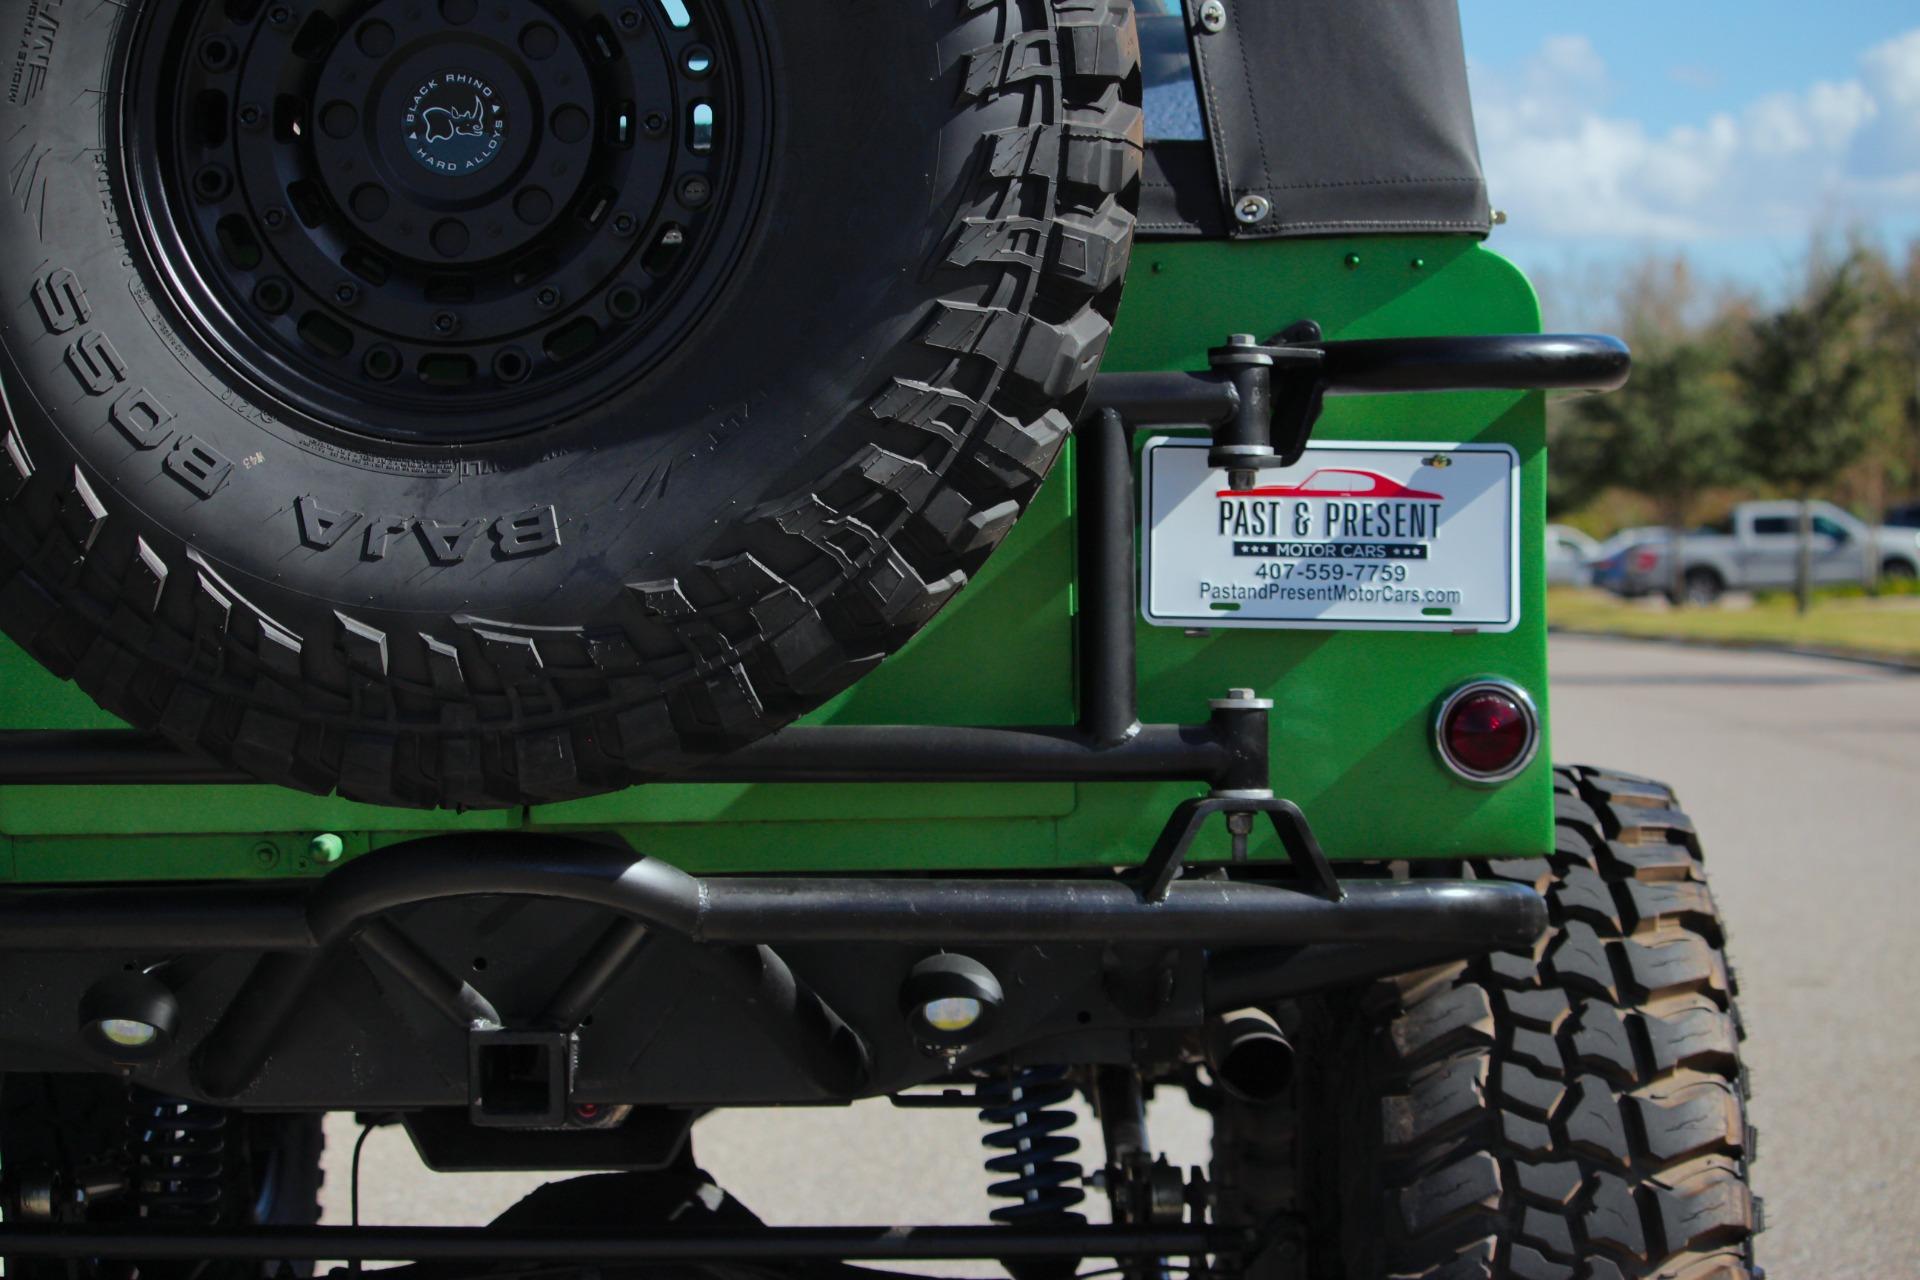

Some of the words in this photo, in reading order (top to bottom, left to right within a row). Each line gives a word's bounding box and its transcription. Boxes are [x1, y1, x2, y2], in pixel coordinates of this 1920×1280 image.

[406, 79, 439, 122] BLACK
[445, 73, 493, 97] RHINO
[416, 147, 457, 171] HARD
[465, 119, 503, 169] ALLOYS
[31, 267, 235, 500] BOSS
[295, 493, 563, 566] BAJA
[1218, 500, 1281, 536] PAST
[1294, 501, 1313, 536] &
[1326, 502, 1443, 539] PRESENT
[1255, 563, 1407, 582] 407-559-7759
[1276, 543, 1337, 558] MOTOR
[1341, 544, 1387, 558] CARS
[1199, 582, 1462, 604] PastandPresentMotorCars.com
